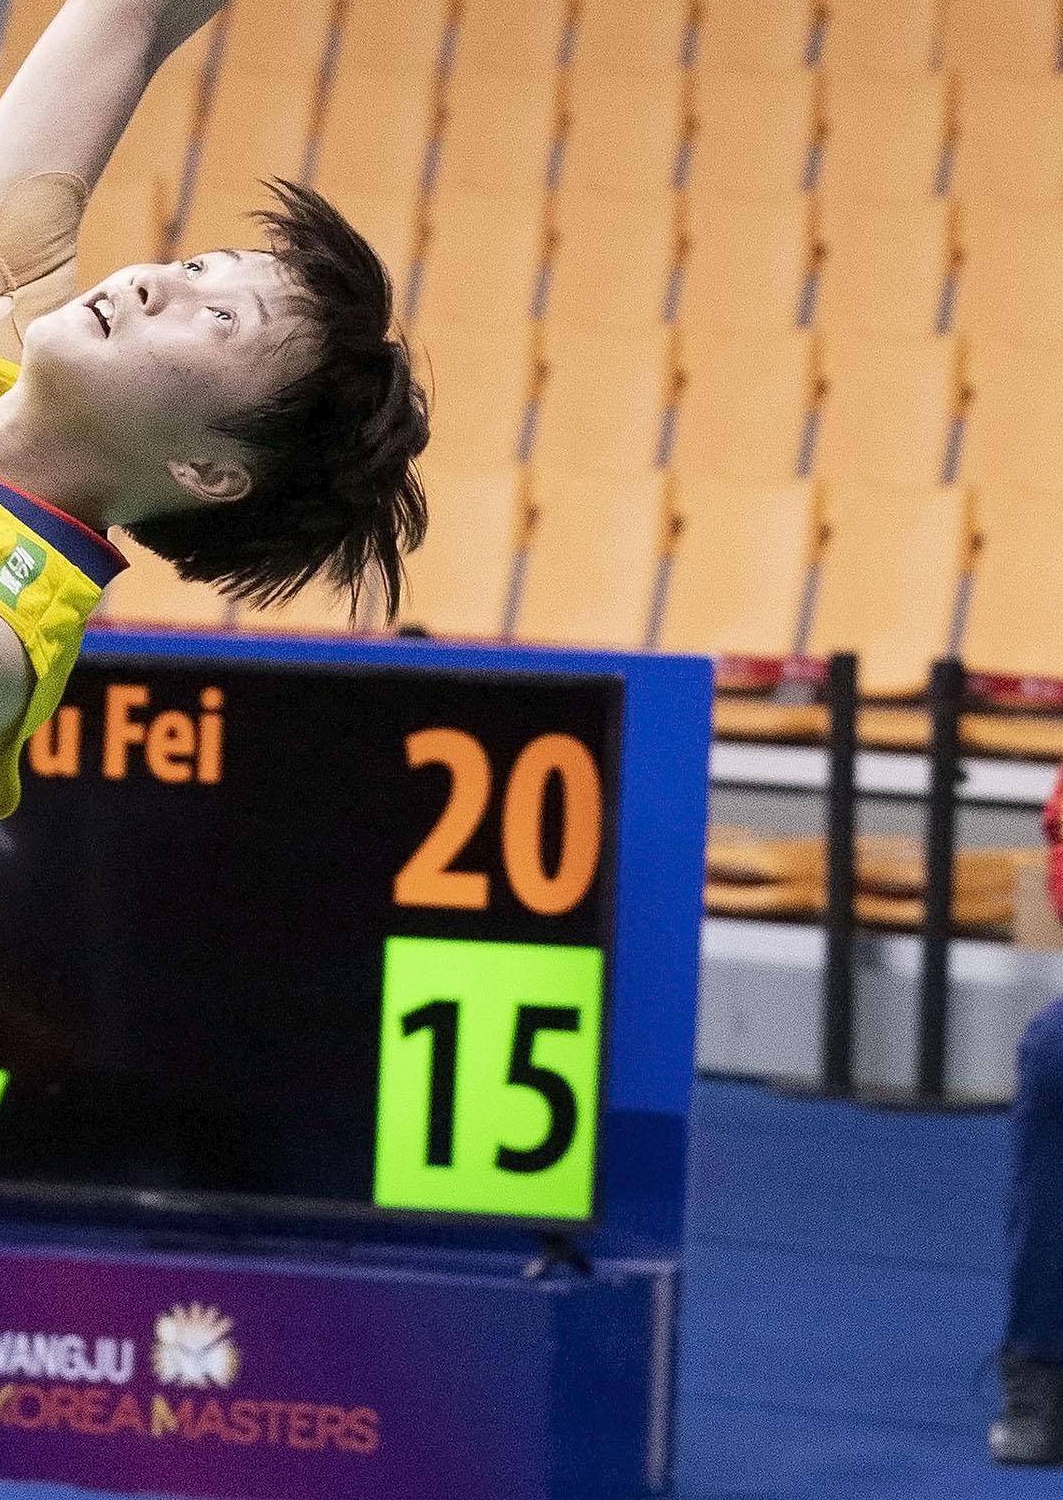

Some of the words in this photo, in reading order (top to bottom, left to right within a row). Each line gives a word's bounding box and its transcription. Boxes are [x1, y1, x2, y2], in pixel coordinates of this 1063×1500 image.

[102, 684, 225, 785] Fei
[393, 727, 603, 916] 20
[399, 998, 582, 1174] 15
[150, 1393, 381, 1453] MASTERS
